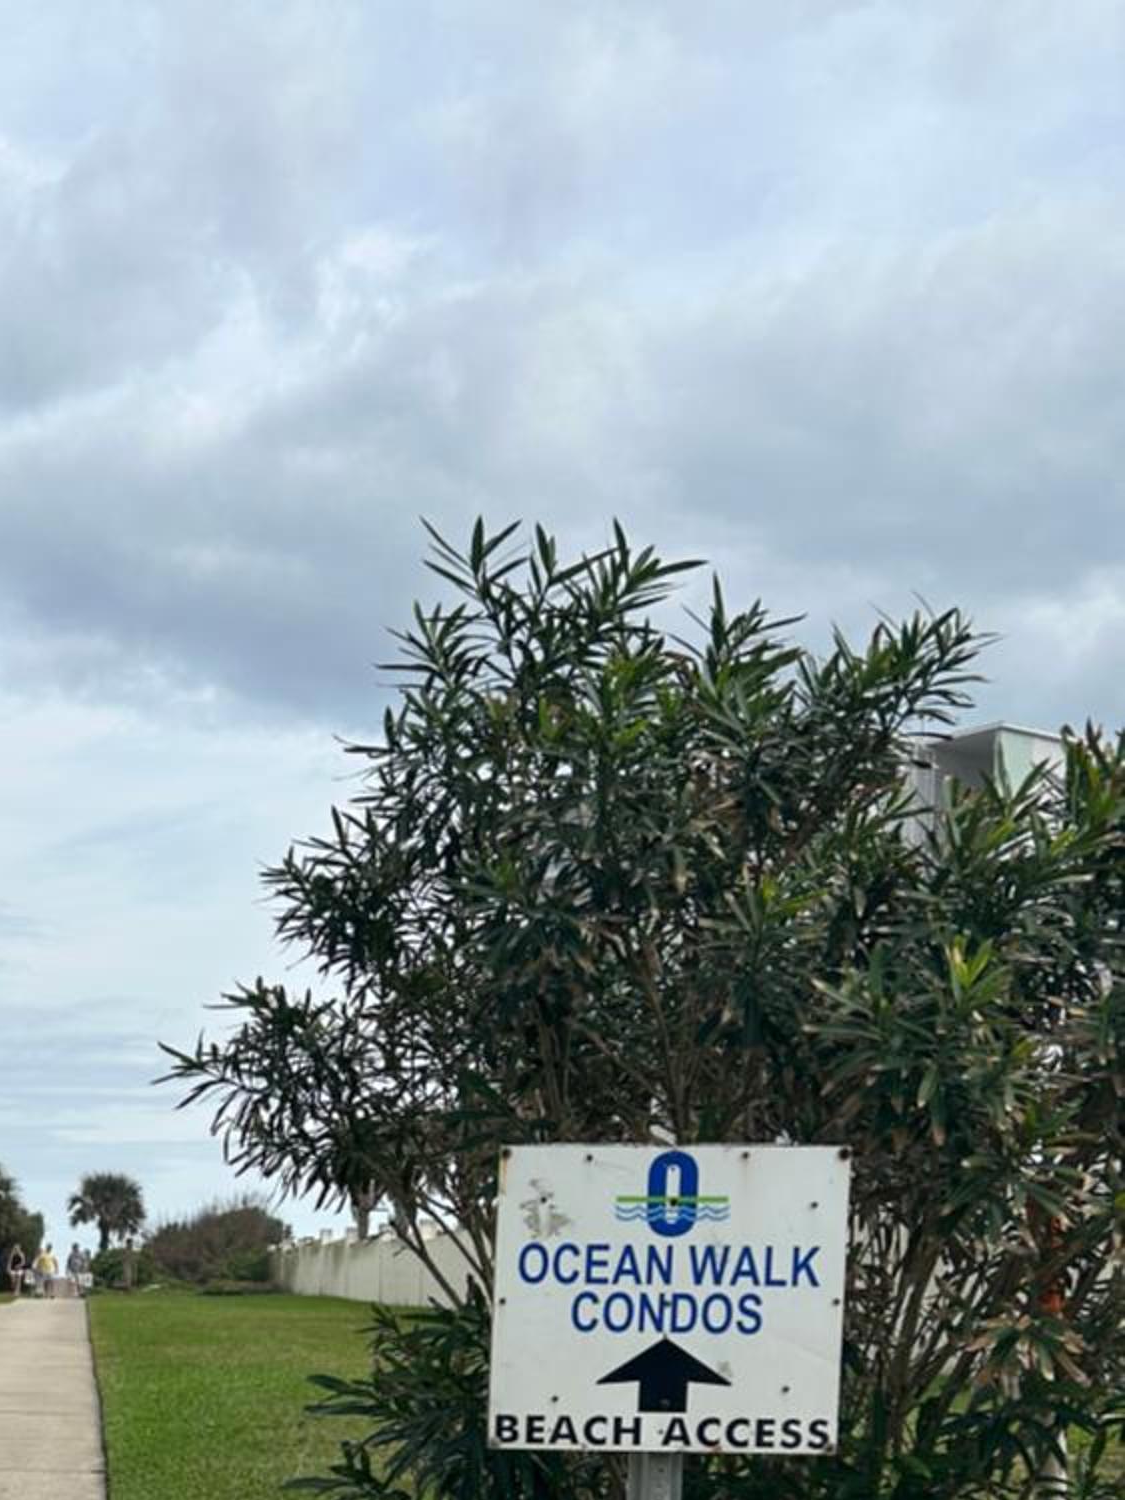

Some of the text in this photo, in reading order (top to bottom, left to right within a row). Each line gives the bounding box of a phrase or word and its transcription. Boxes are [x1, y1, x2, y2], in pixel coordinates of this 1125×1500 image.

[518, 1242, 820, 1287] OCEAN WALK
[571, 1291, 763, 1335] CONDOS
[495, 1415, 829, 1449] BEACH ACCESS
